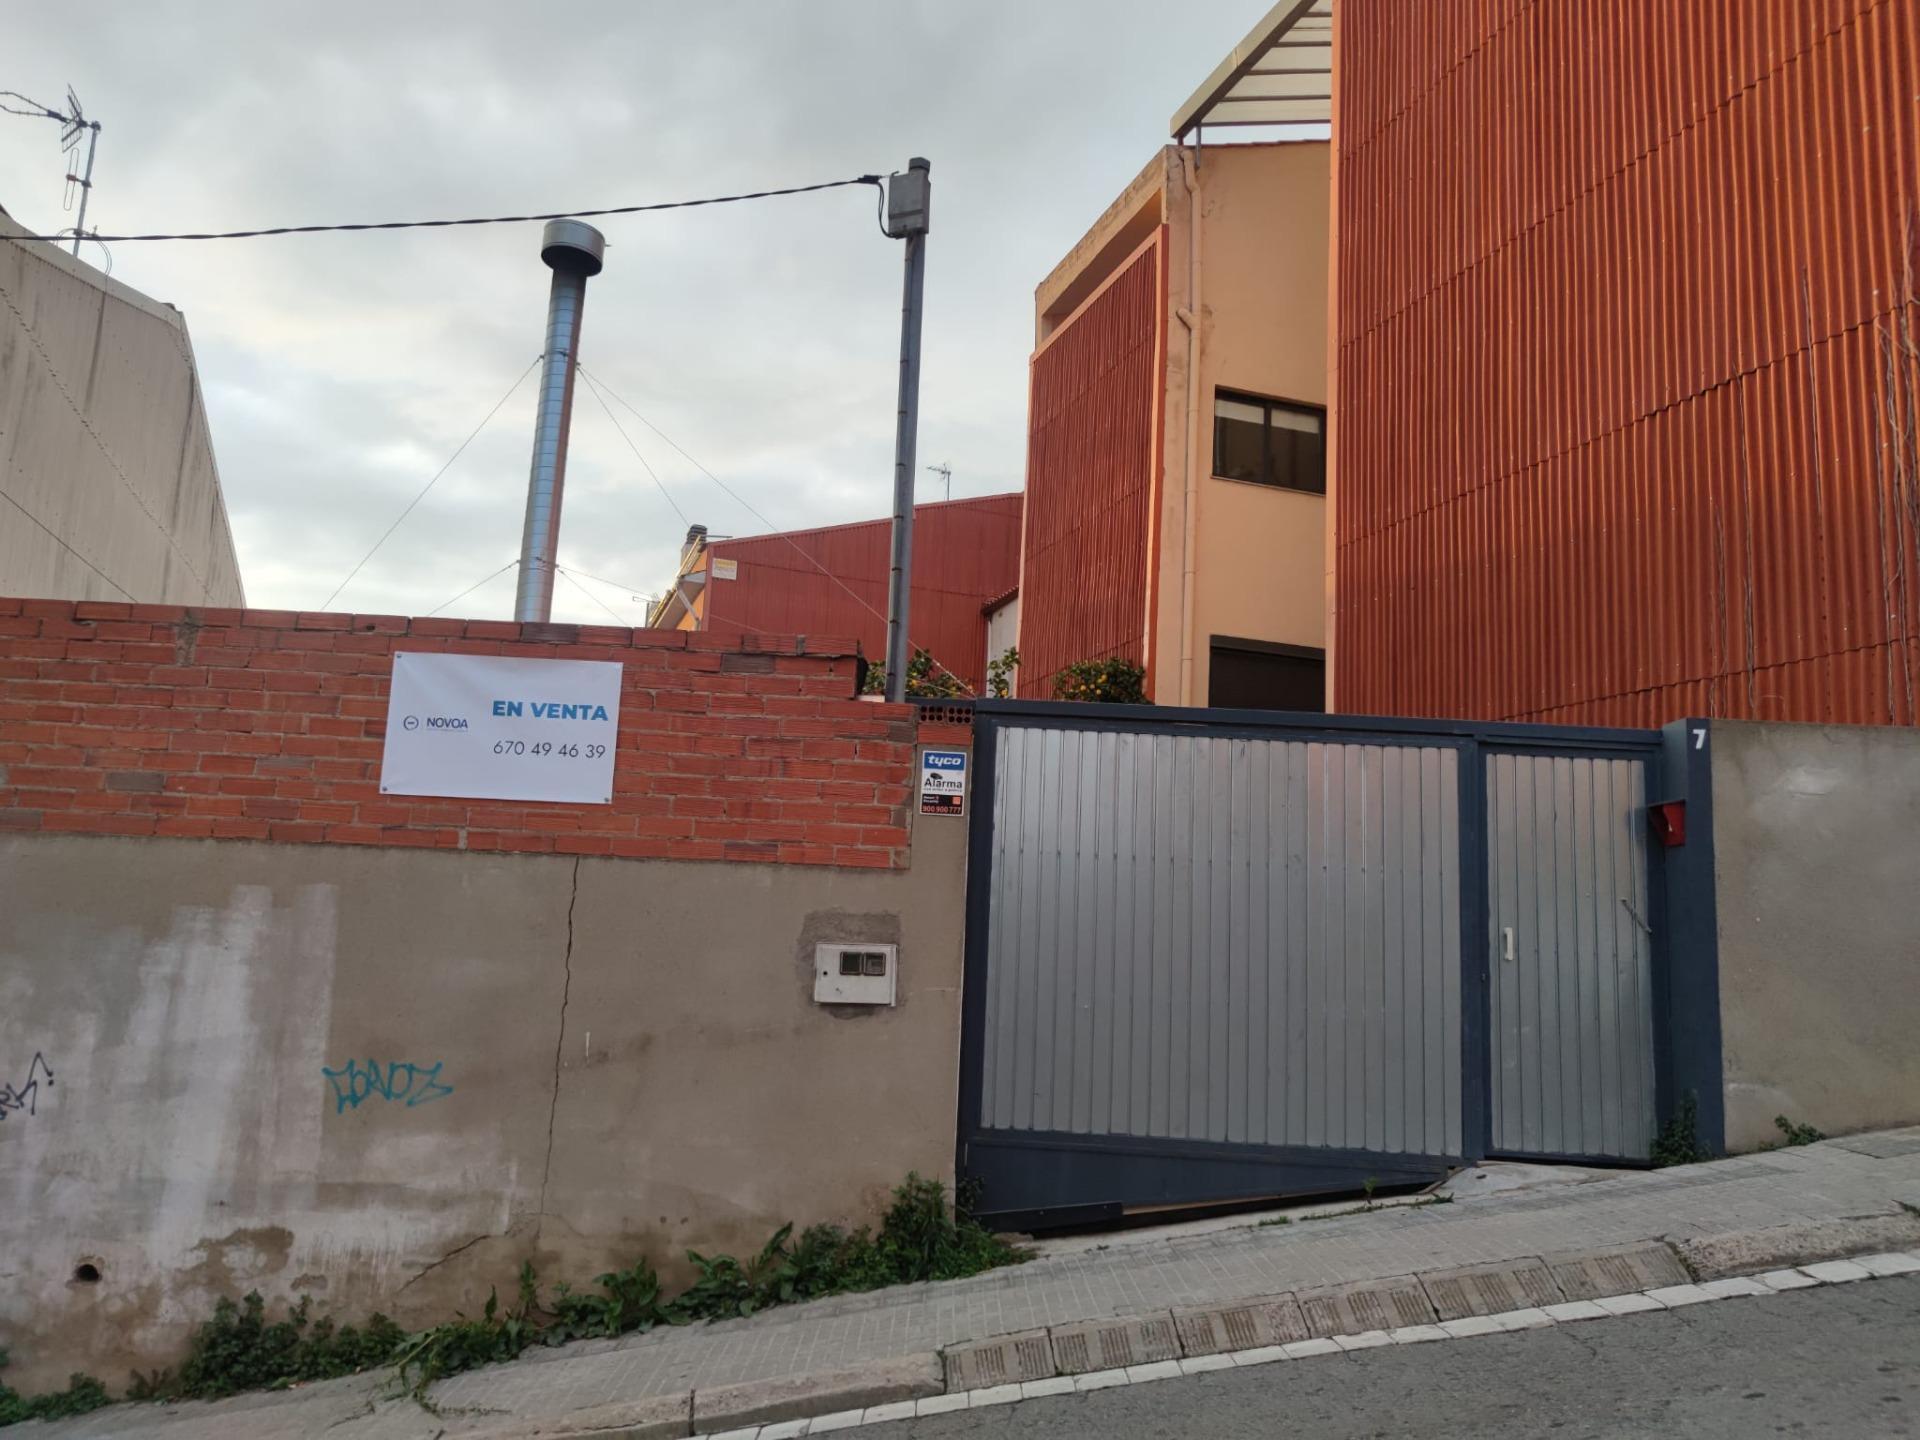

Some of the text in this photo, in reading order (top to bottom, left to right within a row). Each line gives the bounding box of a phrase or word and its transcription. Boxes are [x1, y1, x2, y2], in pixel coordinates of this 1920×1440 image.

[492, 700, 609, 721] EN VENTA
[427, 717, 468, 729] NOVOA
[1692, 729, 1706, 749] 7
[493, 740, 606, 759] 670 49 46 39
[928, 755, 961, 767] tyco
[924, 777, 963, 789] Alarma
